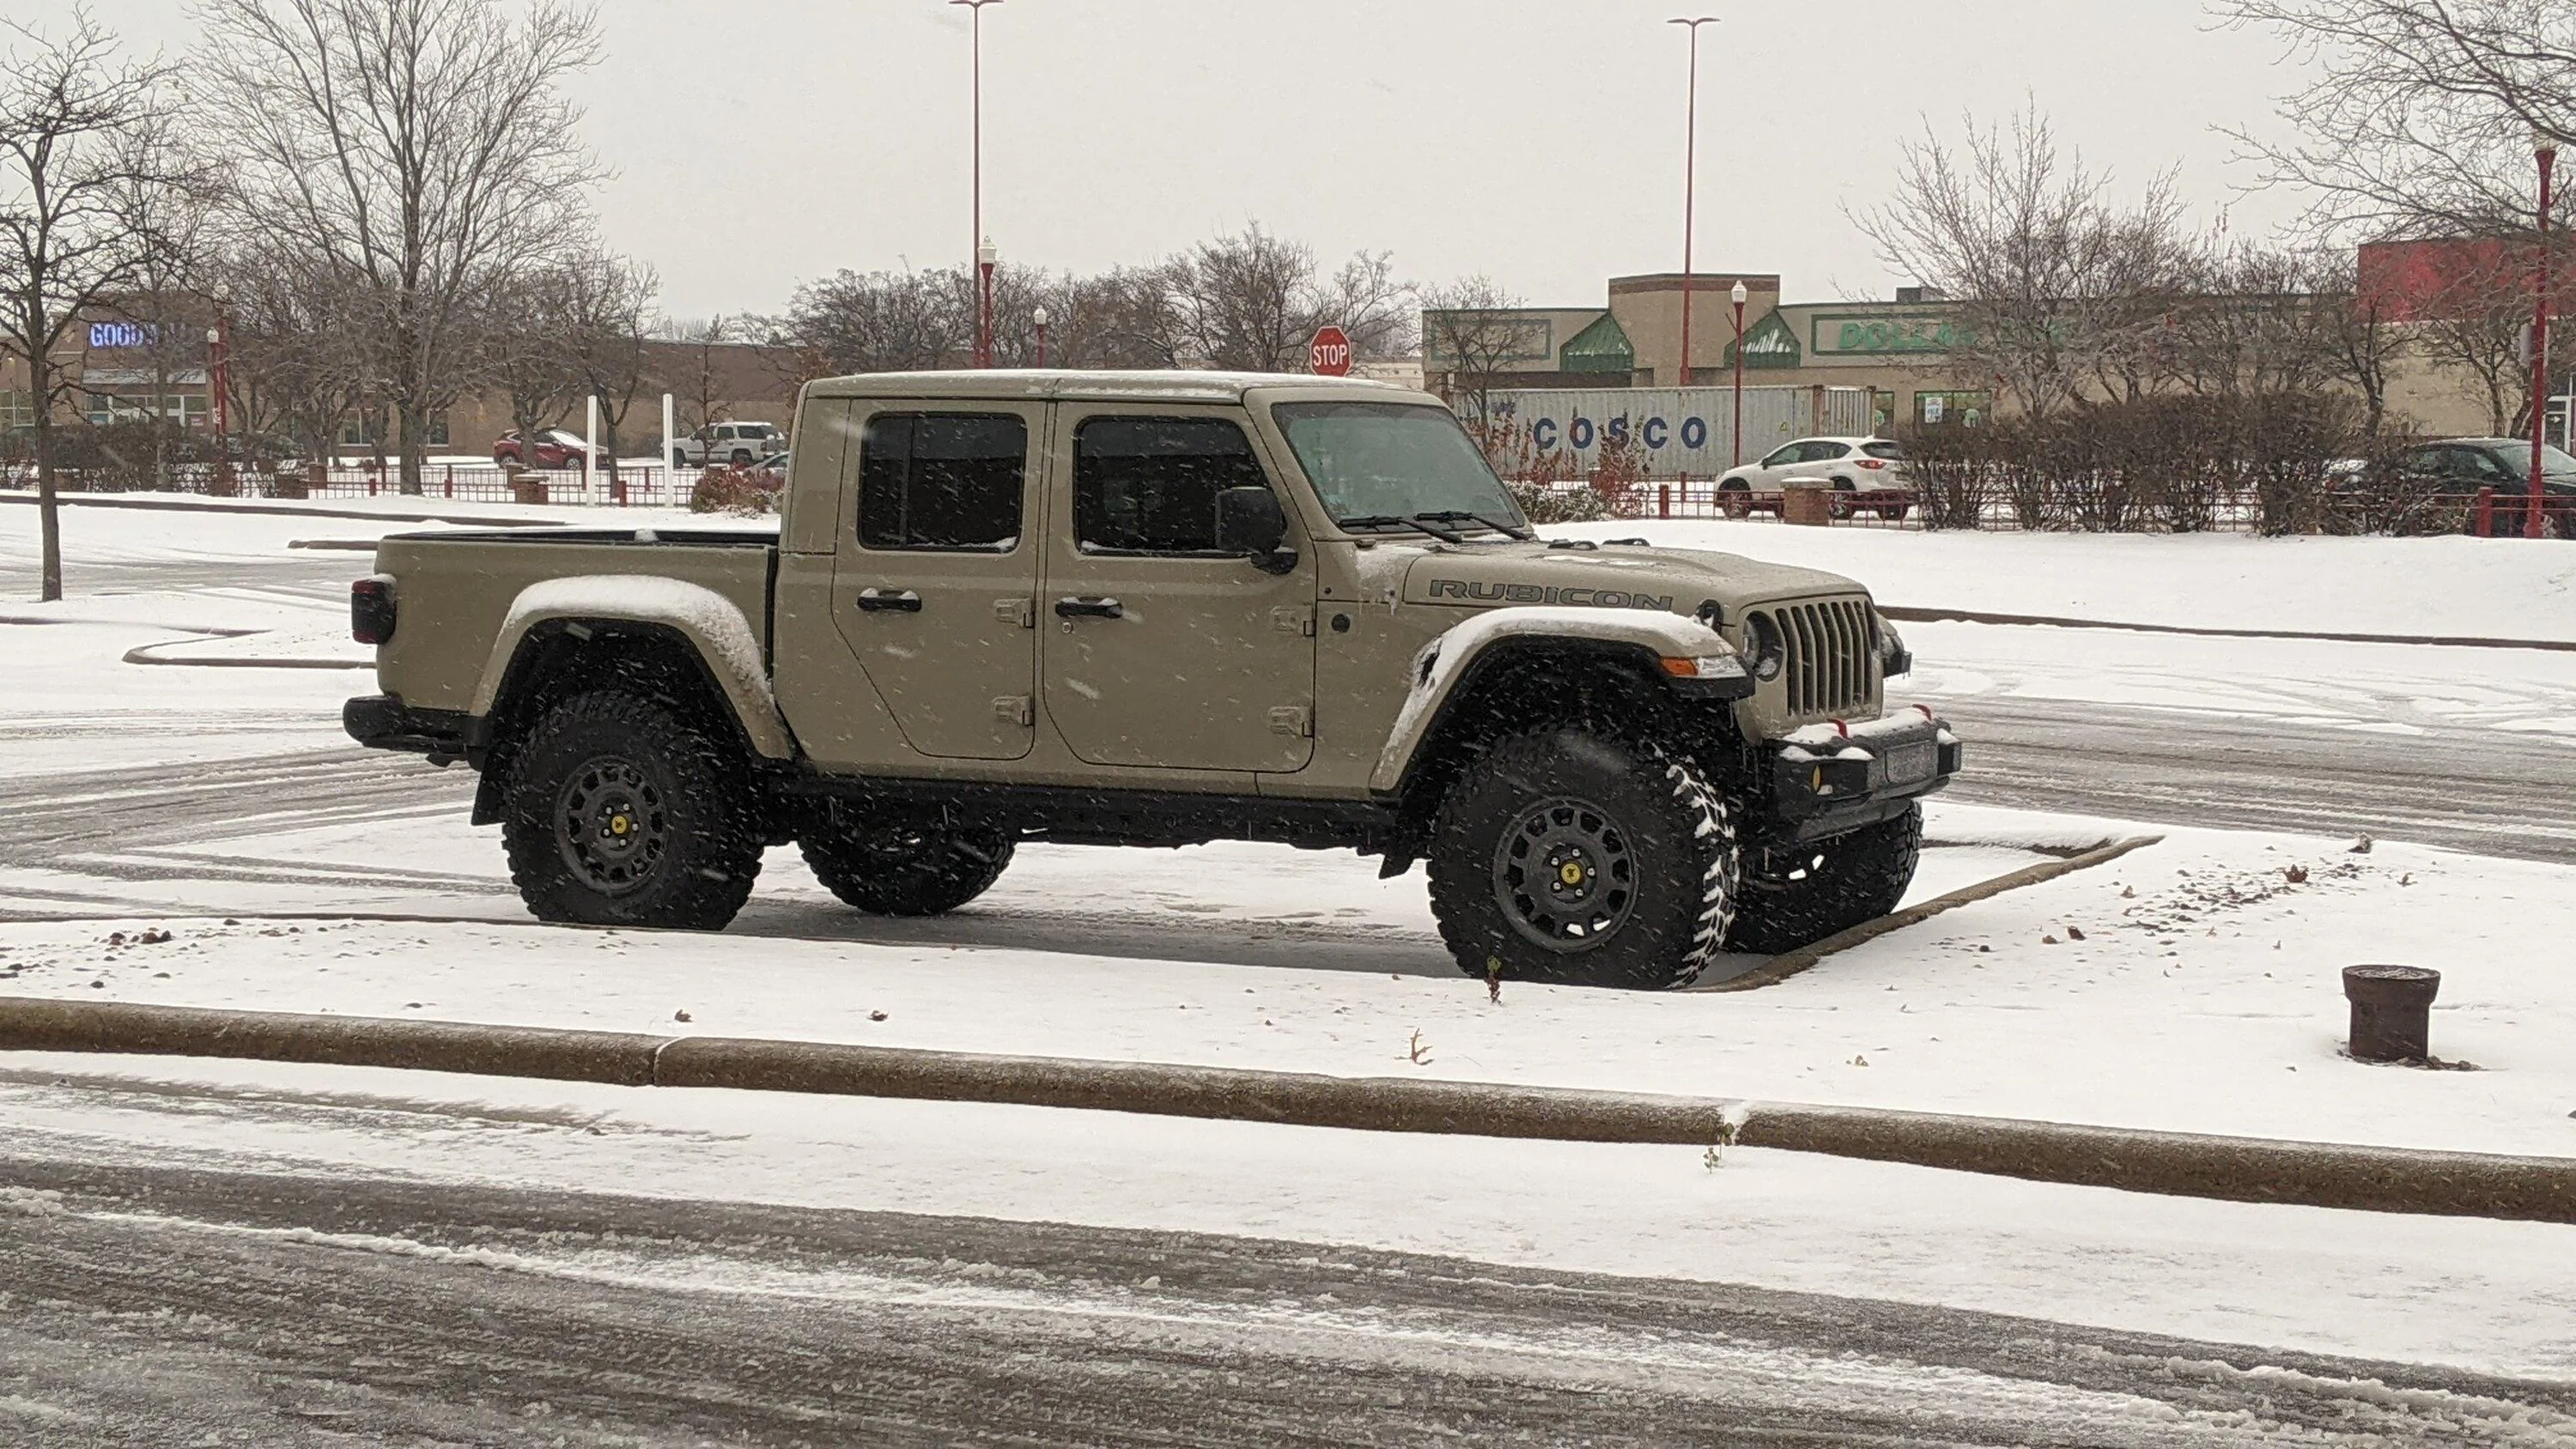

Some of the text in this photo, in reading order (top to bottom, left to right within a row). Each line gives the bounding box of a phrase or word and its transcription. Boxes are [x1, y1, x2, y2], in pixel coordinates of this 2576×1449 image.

[1313, 343, 1348, 367] STOP
[1533, 415, 1707, 450] COSCO
[1428, 579, 1674, 612] RUBICON
